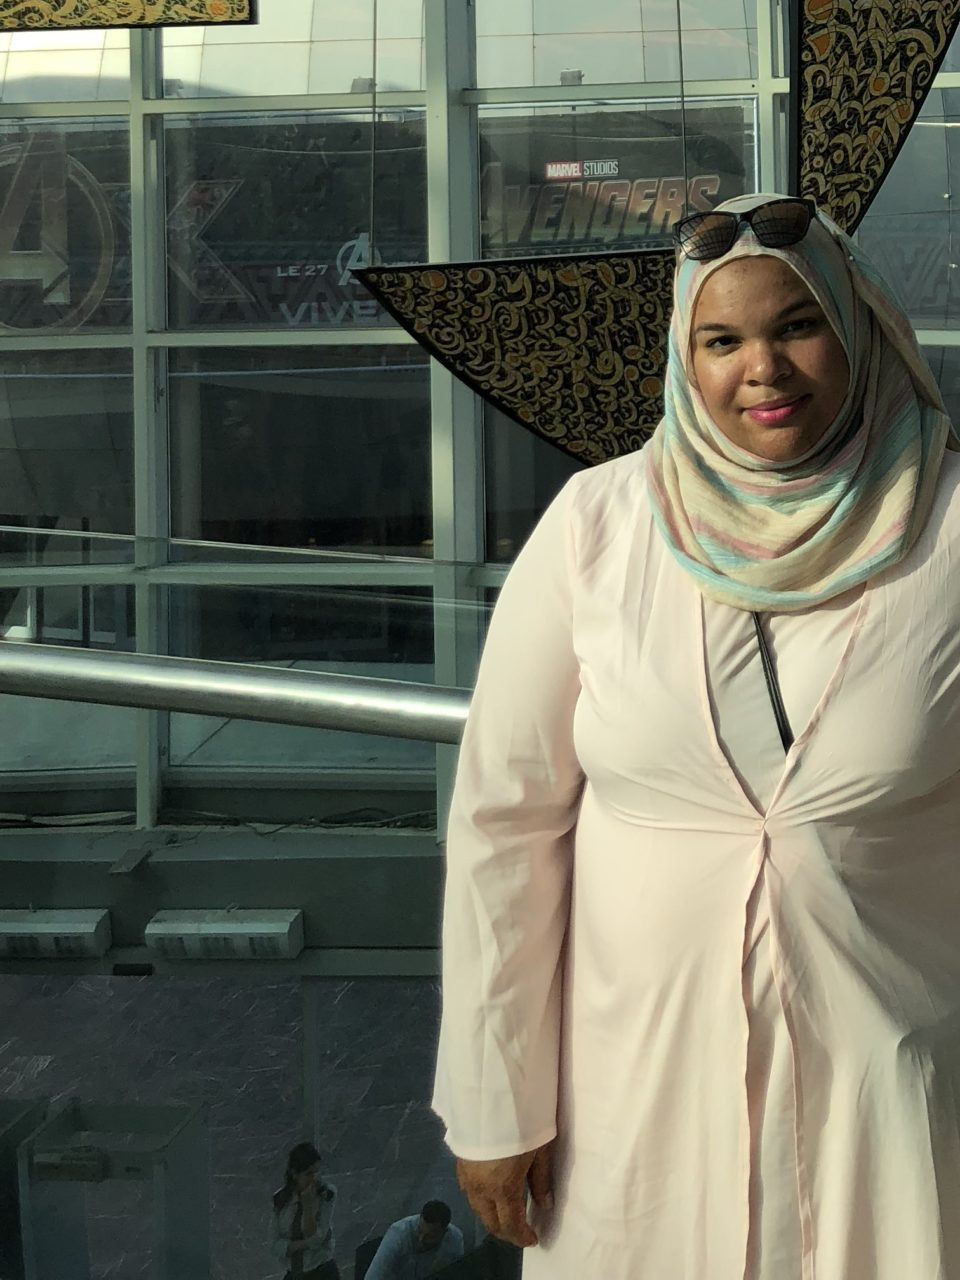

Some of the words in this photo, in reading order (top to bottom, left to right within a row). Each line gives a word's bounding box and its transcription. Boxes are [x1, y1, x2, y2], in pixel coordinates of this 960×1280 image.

[547, 163, 582, 177] MARVEL
[583, 161, 619, 176] STUDIOS
[277, 266, 300, 277] LE
[304, 265, 329, 276] 27
